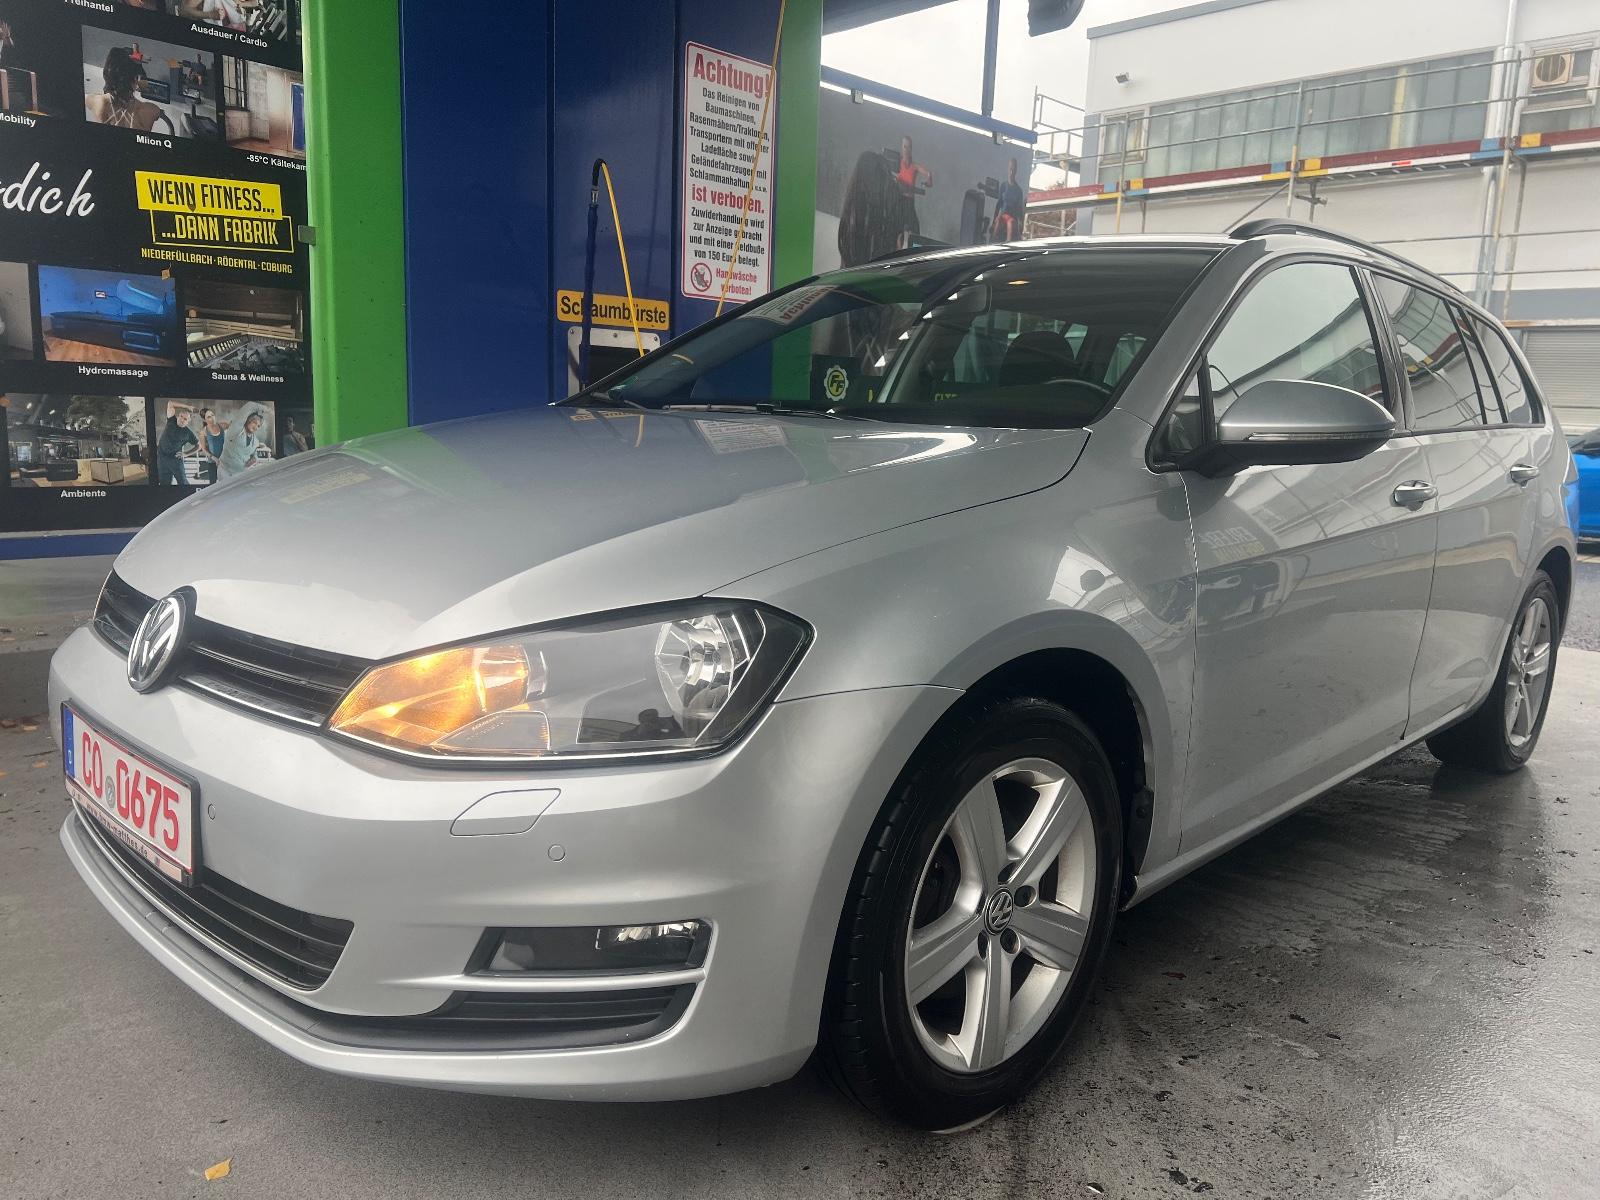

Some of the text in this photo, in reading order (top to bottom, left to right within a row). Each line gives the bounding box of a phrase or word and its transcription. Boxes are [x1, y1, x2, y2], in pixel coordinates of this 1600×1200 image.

[65, 0, 114, 13] reihantel
[190, 23, 268, 48] Ausdauer / Cardio
[694, 52, 770, 99] Achtung!
[702, 87, 760, 111] Das Reinigen von
[705, 102, 756, 125] Baumaschinen,
[689, 111, 770, 141] Rasenmähern/Traktorn,
[164, 139, 172, 149] Q
[690, 126, 733, 144] Transportern
[734, 138, 745, 149] mit
[246, 154, 269, 165] -85°C
[701, 142, 737, 160] Ladefläche
[689, 167, 753, 190] Schlammanhaftun
[756, 169, 767, 180] mit
[3, 161, 95, 217] dich
[147, 178, 275, 214] WENN FITNESS...
[692, 183, 764, 213] ist verboten.
[162, 214, 279, 245] ...DANN FABRIK
[693, 222, 762, 241] zur Anzeige gbracht
[750, 219, 764, 229] wird
[689, 235, 765, 254] und mit einer eldbuße
[141, 247, 293, 274] NIEDERFÜLLBACH RÖDENTAL COBURG
[694, 249, 760, 267] von 150 Eur belegt.
[720, 283, 752, 295] vrboten!
[78, 365, 149, 378] Hydromassage
[211, 372, 285, 383] Sauna & Wellness
[60, 488, 107, 498] Ambiente
[82, 731, 179, 852] CO 0675
